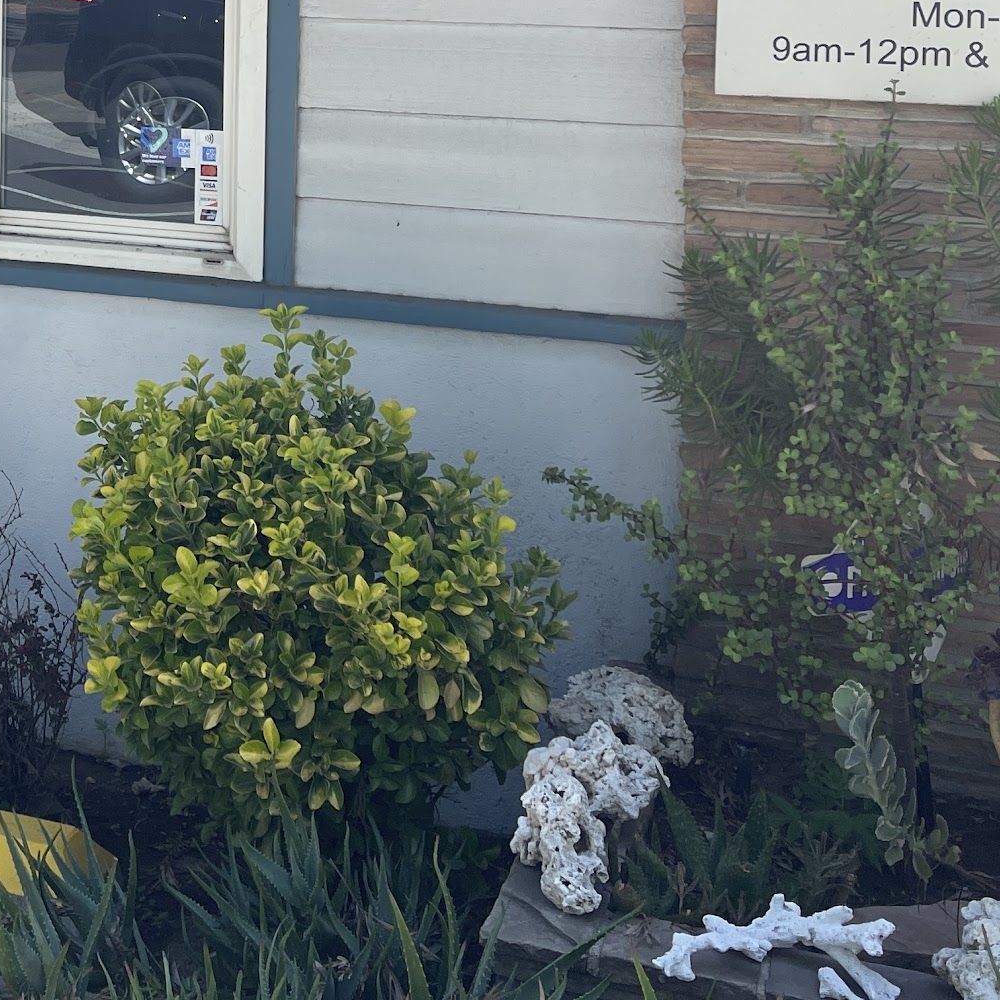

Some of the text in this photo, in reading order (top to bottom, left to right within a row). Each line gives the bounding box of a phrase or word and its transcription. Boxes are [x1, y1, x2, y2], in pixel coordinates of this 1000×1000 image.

[912, 1, 1000, 29] Mon-
[772, 35, 989, 71] 9am-12pm &
